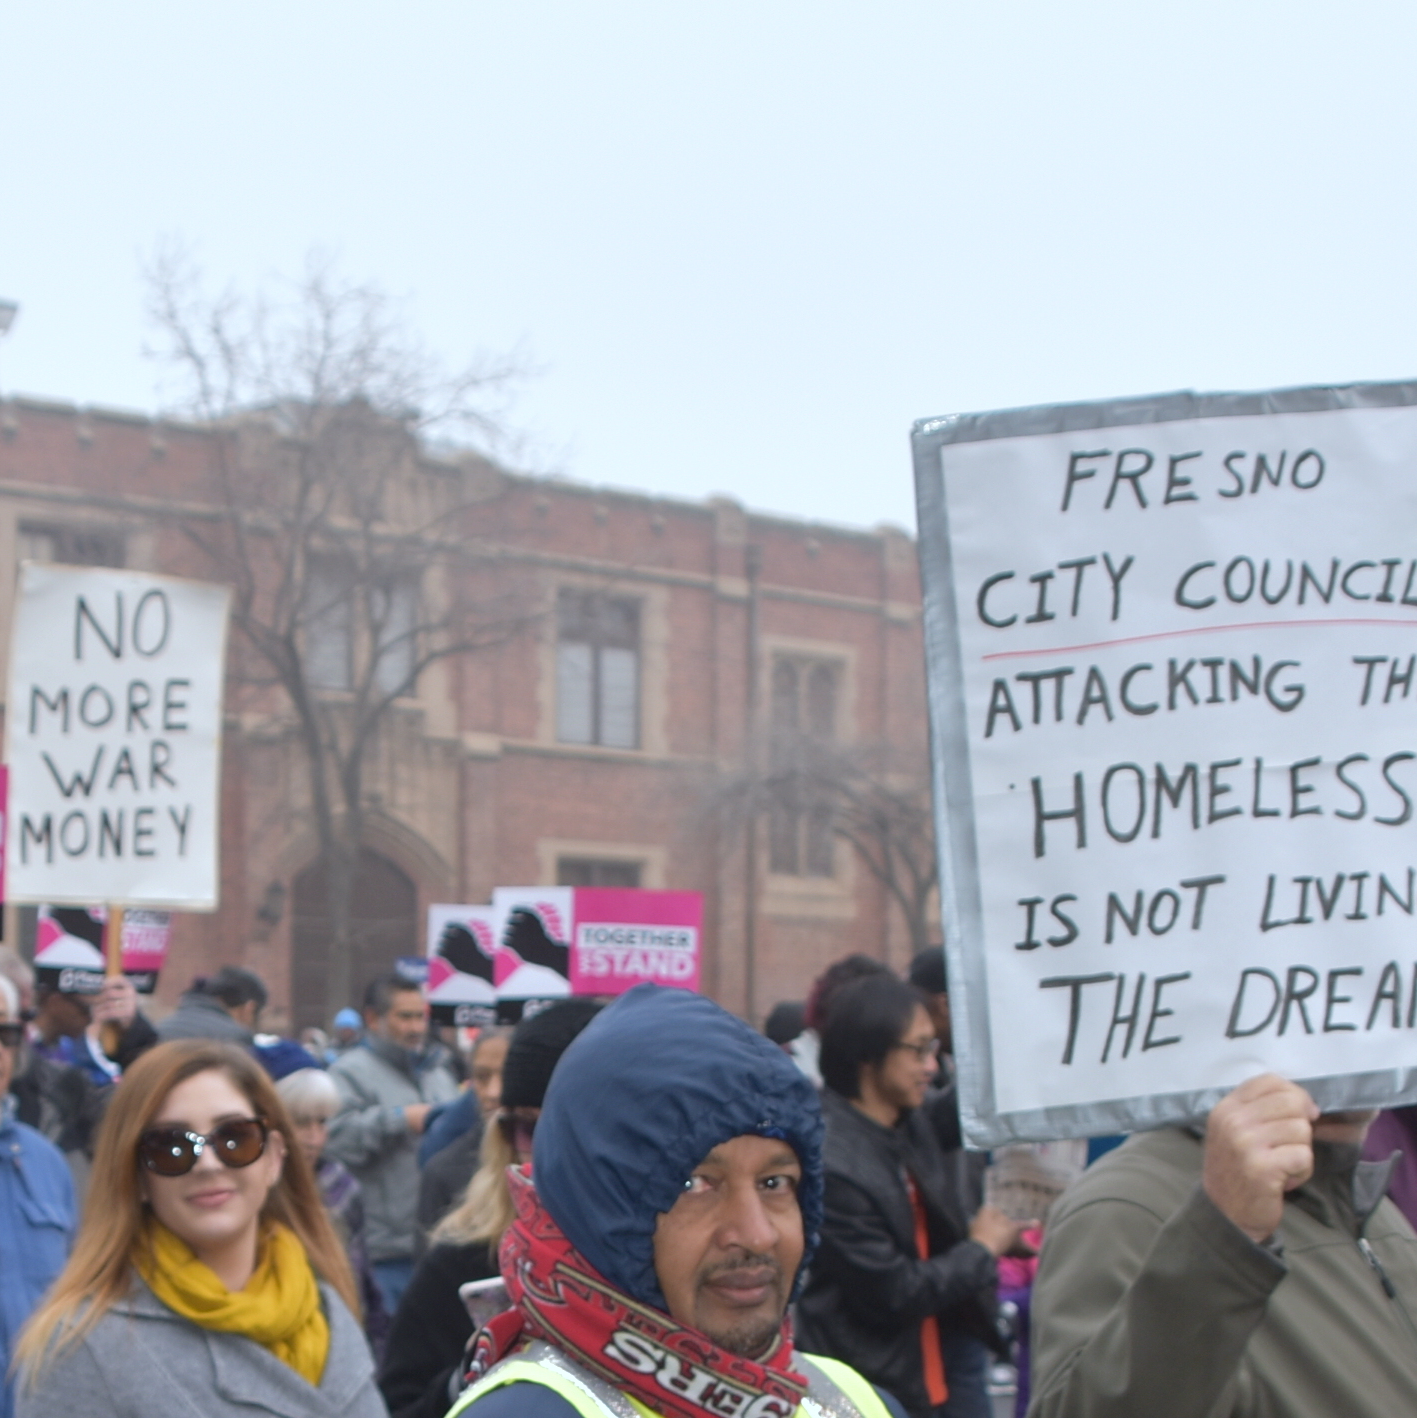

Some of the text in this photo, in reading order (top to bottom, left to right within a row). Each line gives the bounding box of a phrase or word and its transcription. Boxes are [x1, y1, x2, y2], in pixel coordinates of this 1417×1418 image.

[1060, 448, 1326, 512] FRESNO
[75, 588, 169, 660] NO
[976, 553, 1134, 629] CITY
[29, 678, 191, 734] MORE
[984, 654, 1306, 738] ATTACKING
[42, 741, 176, 798] WAR
[20, 806, 190, 864] MONEY
[1030, 751, 1416, 859] HOMELESS
[582, 926, 691, 947] TOGETHER
[1014, 894, 1079, 951] IS
[1105, 875, 1226, 944] NOT
[594, 950, 695, 980] STAND
[1039, 972, 1191, 1065] THE
